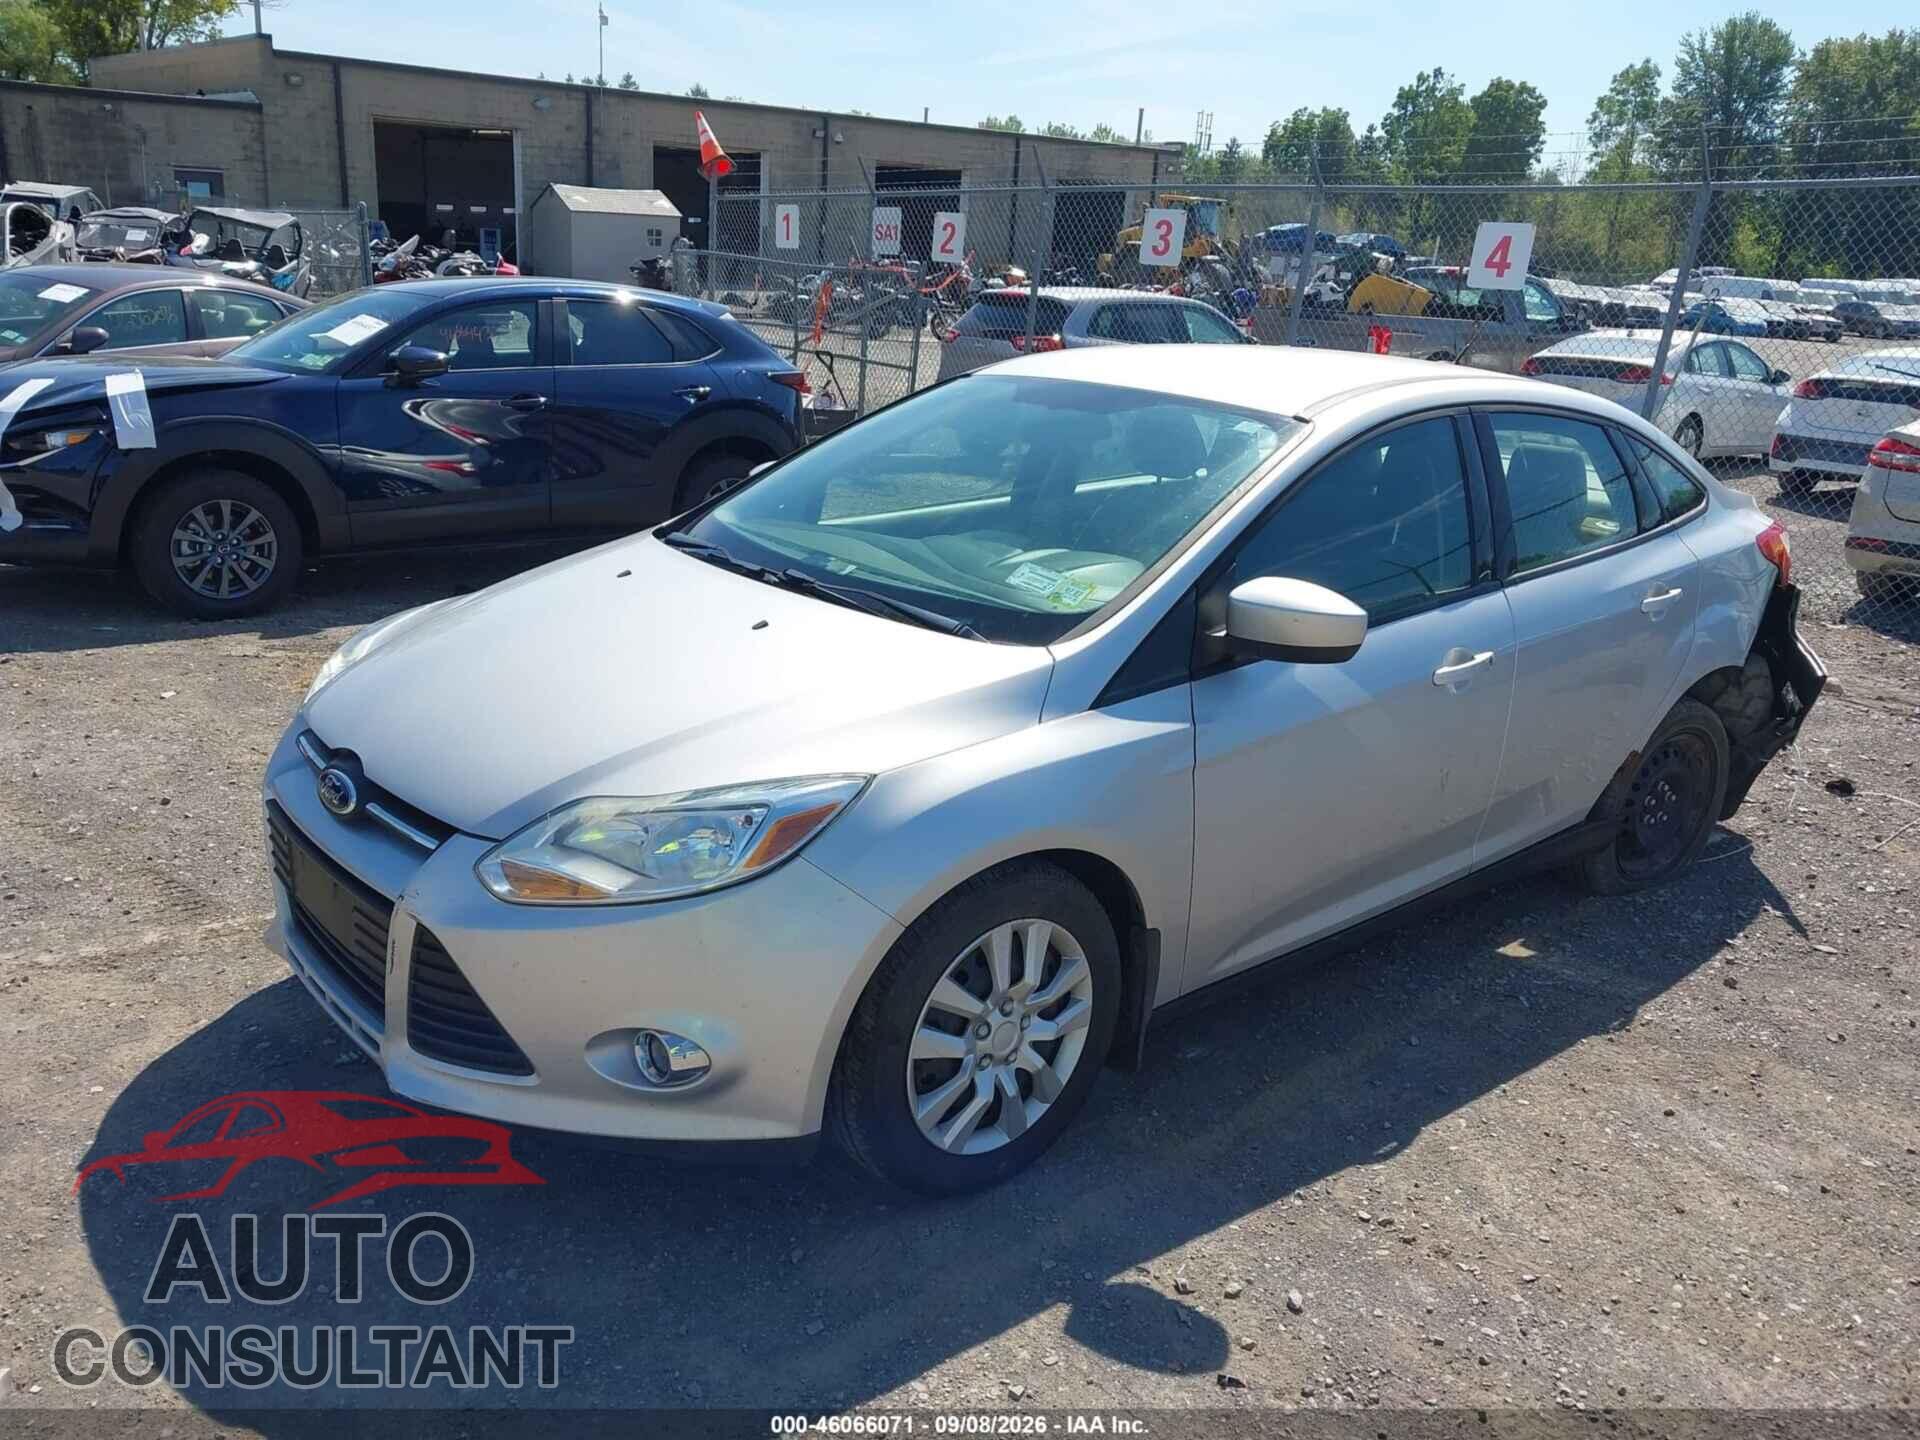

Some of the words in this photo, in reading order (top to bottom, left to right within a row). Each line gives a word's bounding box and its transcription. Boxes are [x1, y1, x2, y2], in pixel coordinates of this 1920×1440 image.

[782, 213, 791, 241] 1
[874, 223, 899, 242] SA1
[939, 221, 957, 255] 2
[1151, 219, 1173, 257] 3
[1484, 235, 1513, 278] 4
